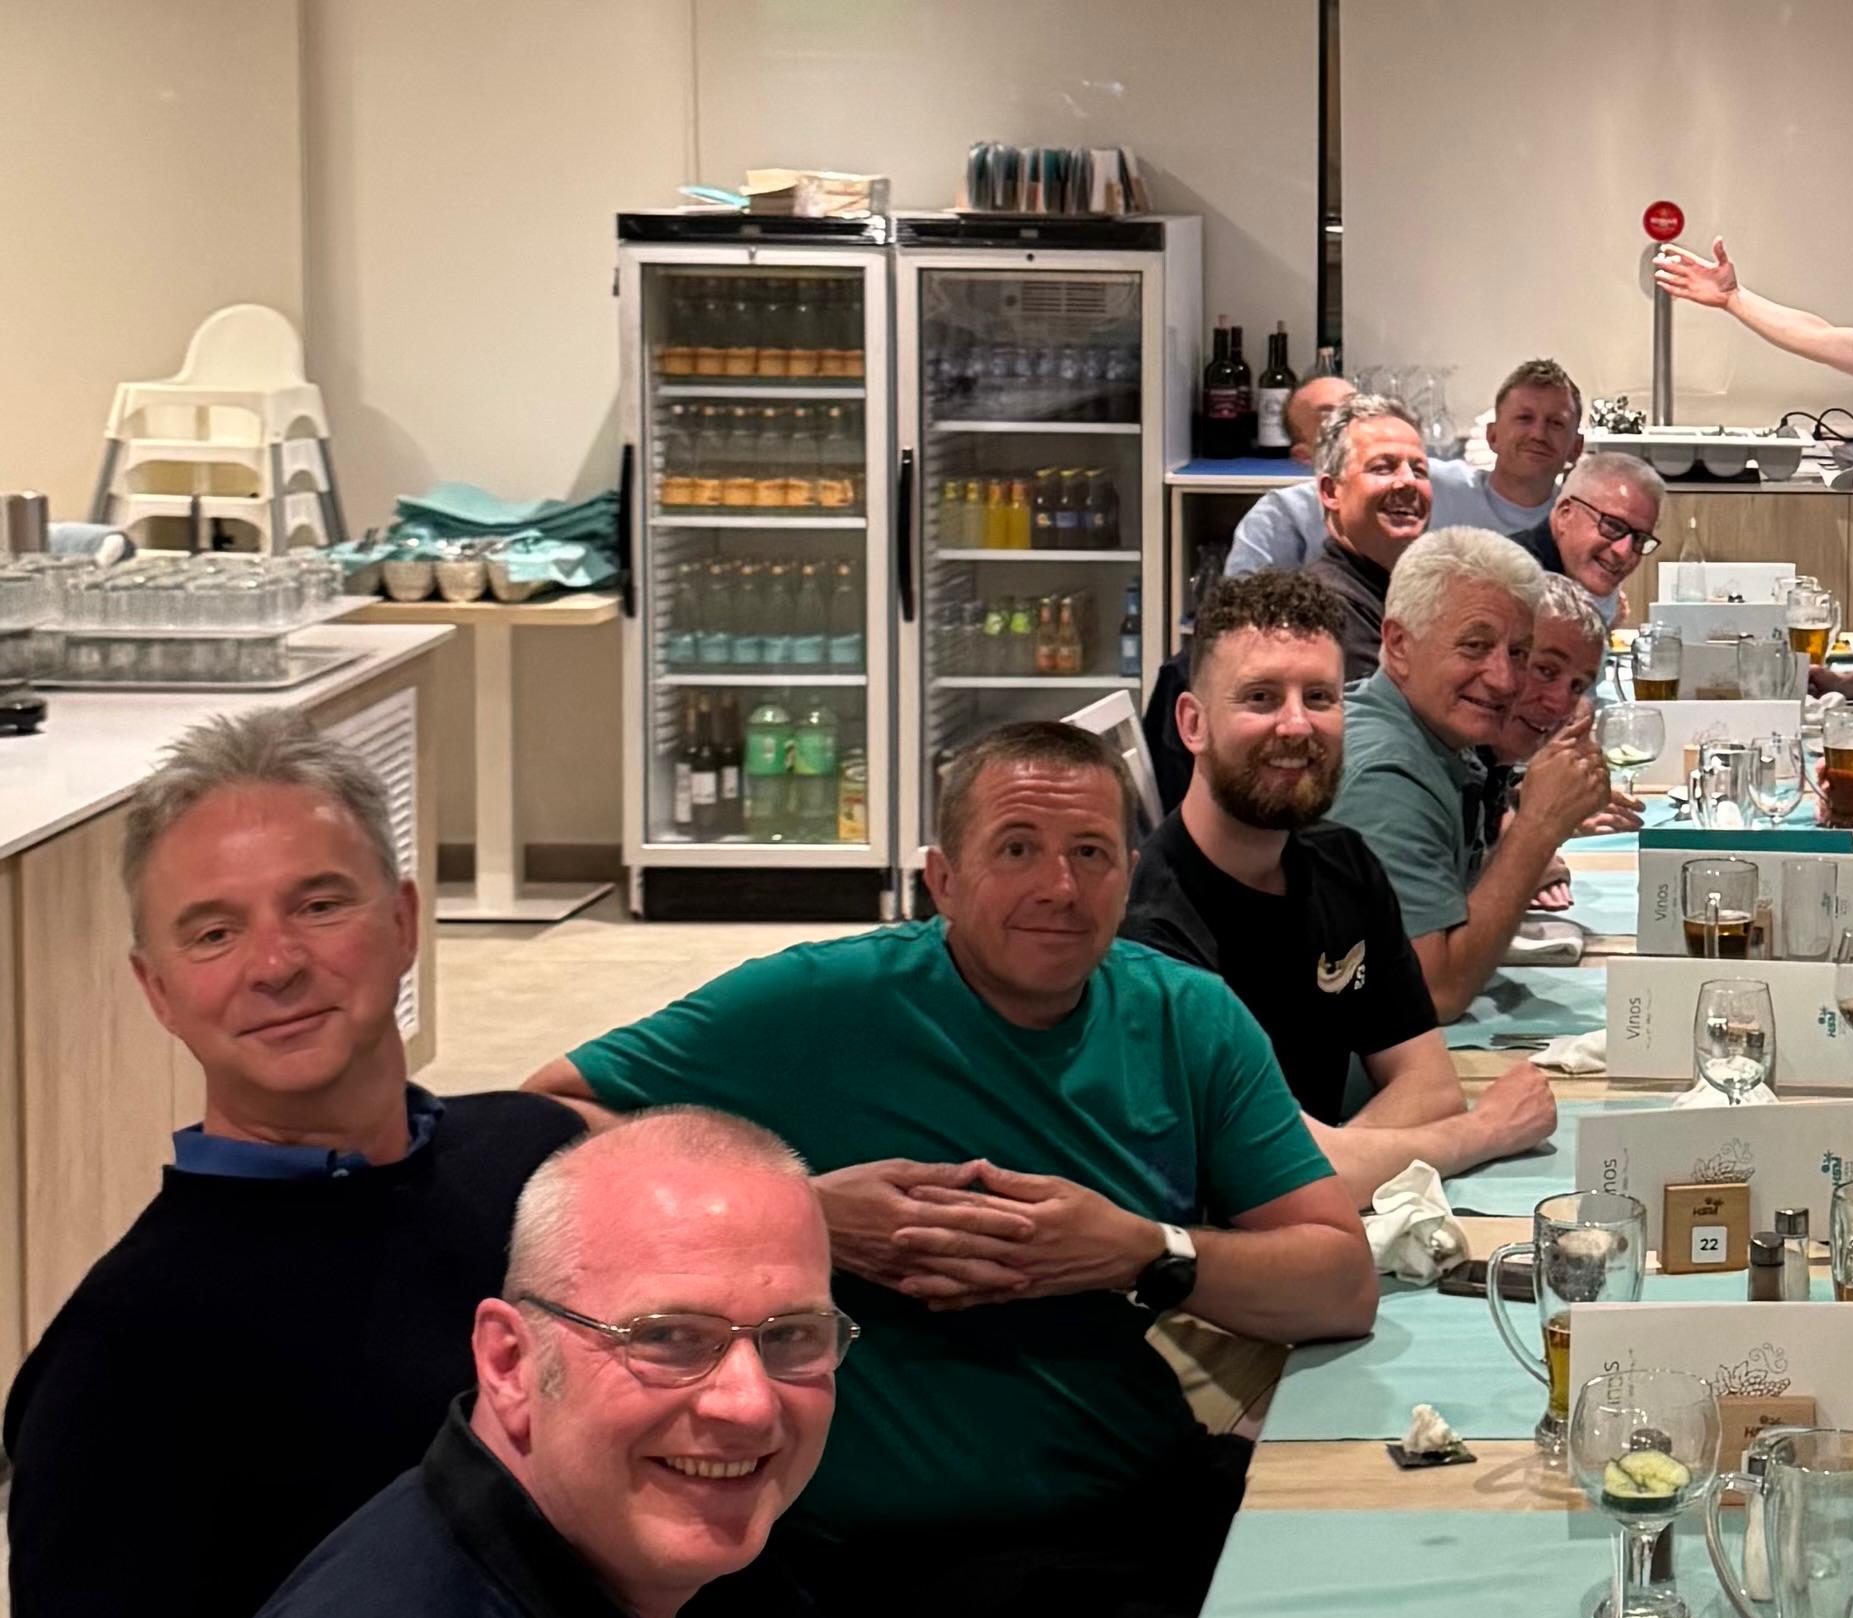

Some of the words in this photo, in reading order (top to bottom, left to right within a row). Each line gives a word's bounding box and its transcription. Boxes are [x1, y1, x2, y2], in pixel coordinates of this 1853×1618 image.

[1654, 883, 1669, 921] Vinos
[1626, 997, 1642, 1041] Vinos
[1700, 1238, 1719, 1251] 22
